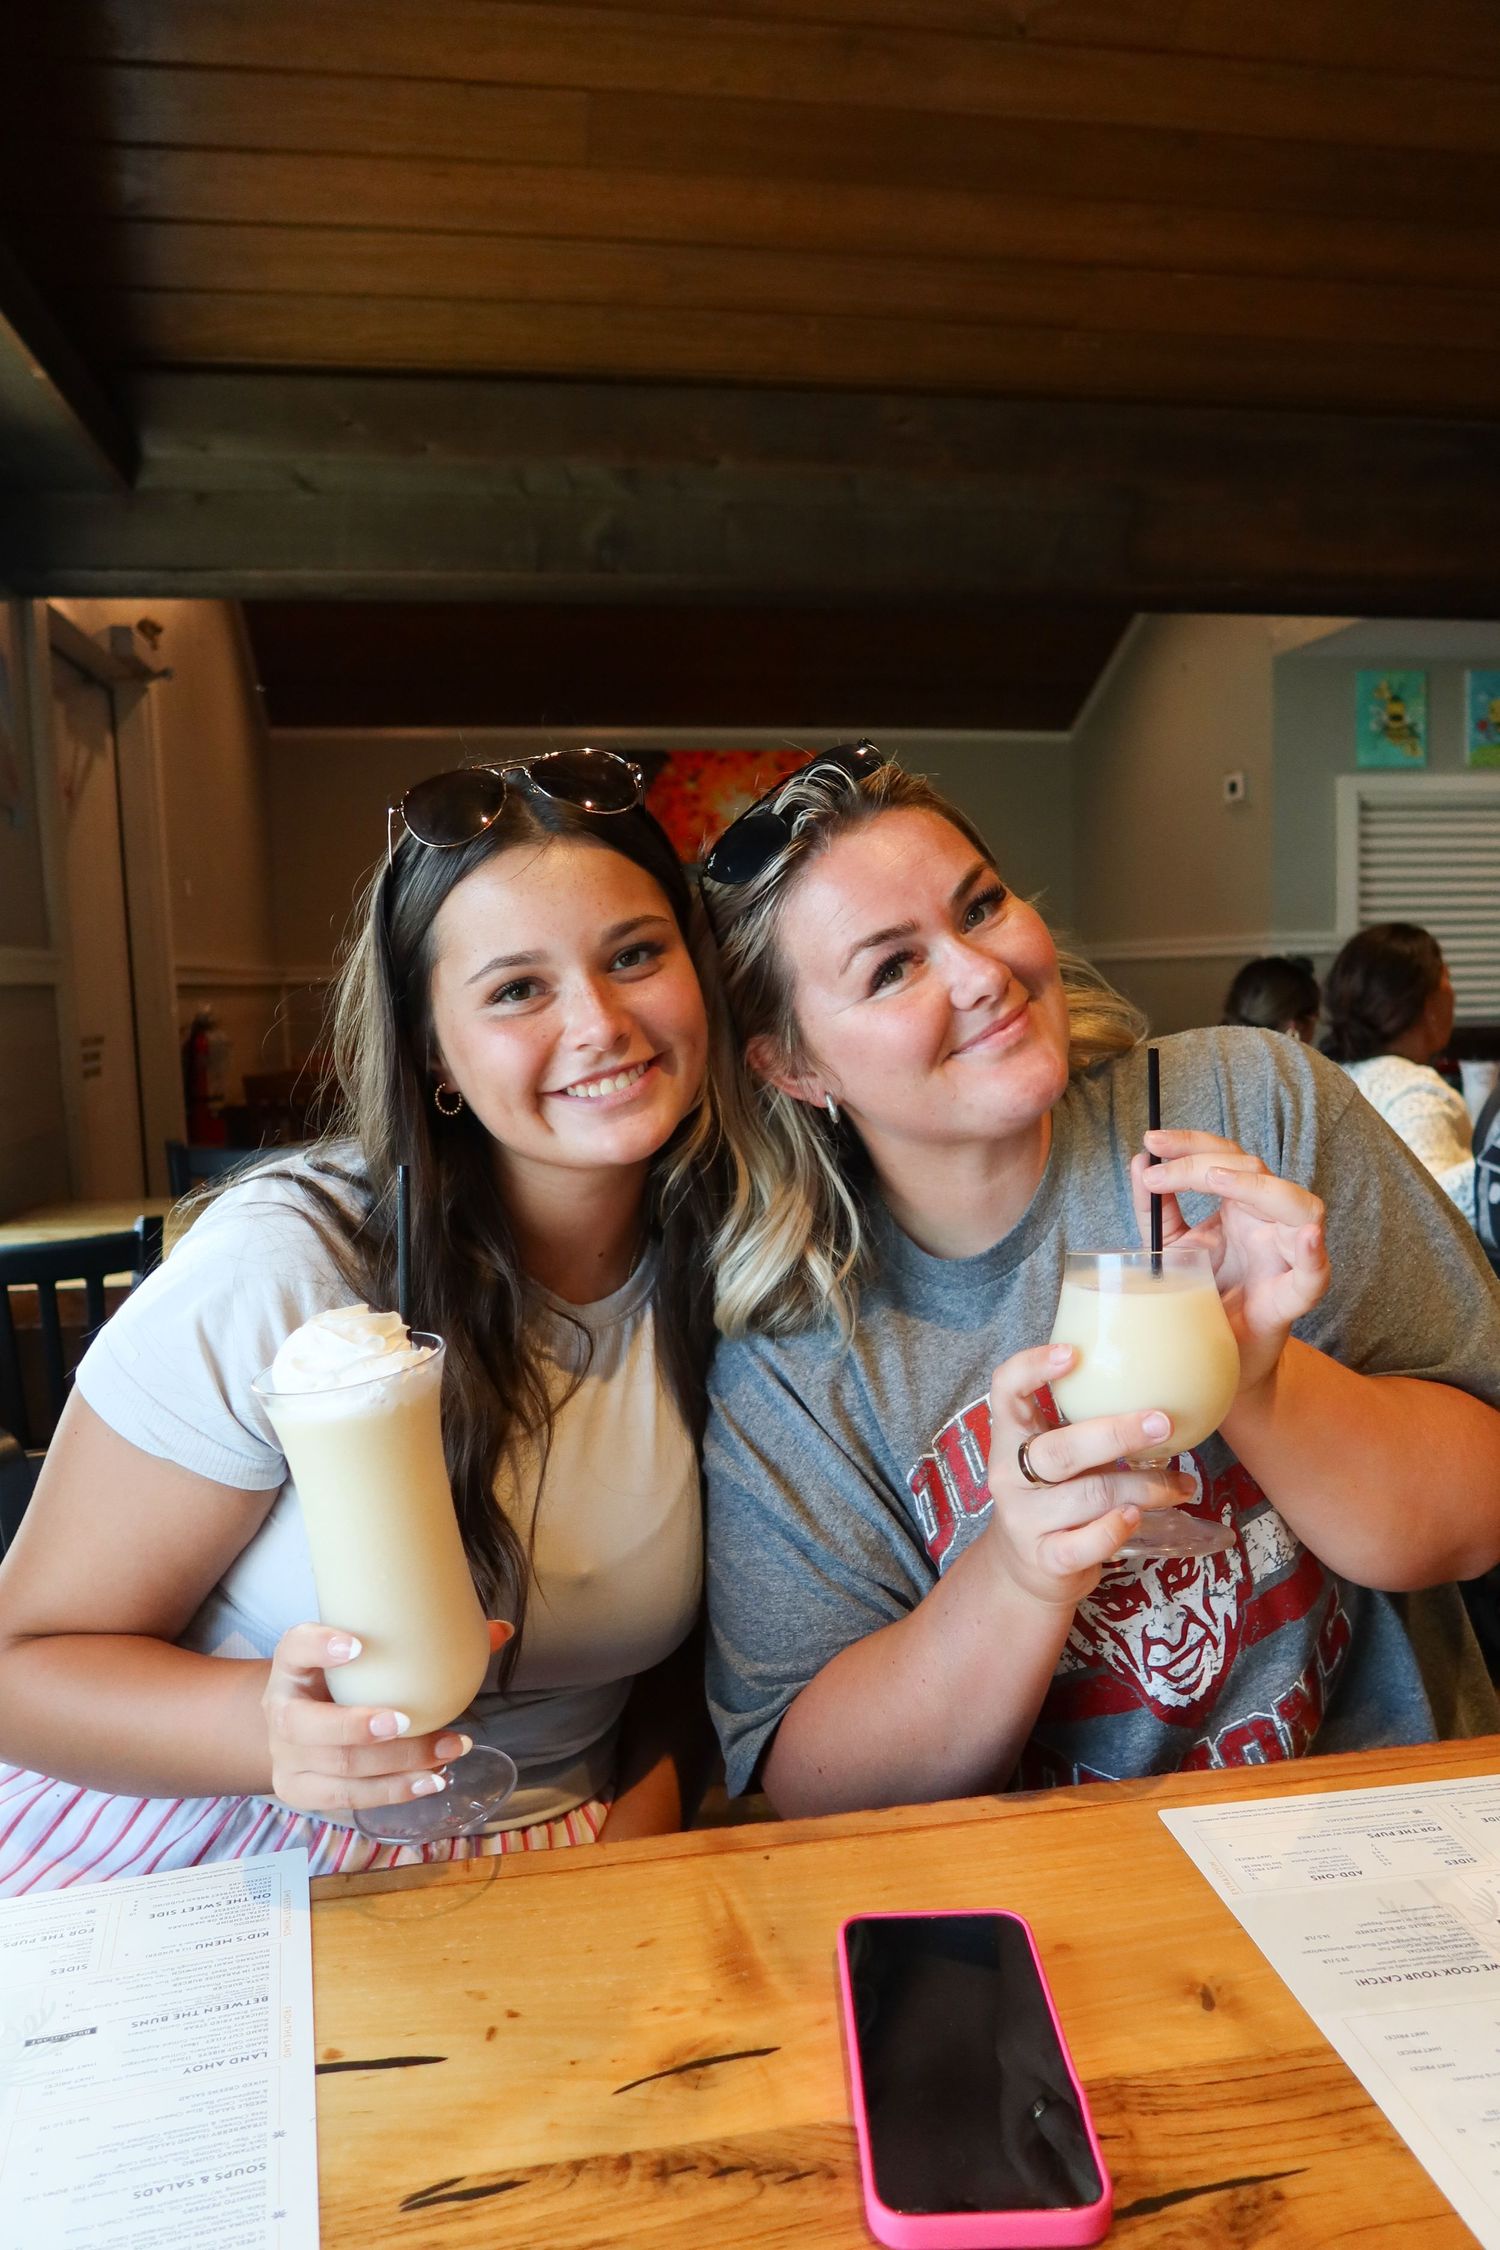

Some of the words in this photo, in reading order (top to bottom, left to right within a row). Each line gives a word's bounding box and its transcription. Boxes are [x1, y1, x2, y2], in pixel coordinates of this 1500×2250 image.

[1366, 1830, 1394, 1838] PUPS
[1395, 1827, 1418, 1835] THE
[1420, 1824, 1442, 1832] FOR
[1444, 1856, 1477, 1865] SIDES
[1309, 1869, 1362, 1881] ADD-ONS
[224, 1896, 248, 1905] THE
[252, 1891, 270, 1900] ON
[180, 1900, 222, 1913] SWEET
[147, 1909, 176, 1919] SIDE
[40, 1932, 64, 1941] THE
[68, 1927, 94, 1936] FOR
[235, 1930, 269, 1942] KID'S
[2, 1937, 36, 1948] PUPS
[194, 1937, 231, 1949] MENU
[50, 1963, 88, 1975] SIDES
[1443, 1964, 1478, 1976] COOK
[1480, 1962, 1500, 1971] WE
[1353, 1973, 1402, 1986] CATCH!
[1403, 1969, 1438, 1980] YOUR
[203, 1995, 268, 2013] BETWEEN
[172, 2008, 199, 2020] THE
[130, 2015, 168, 2028] BUNS
[228, 2051, 267, 2064] LAND
[182, 2060, 224, 2074] AHOY
[214, 2162, 266, 2182] SOUPS
[199, 2174, 209, 2185] &
[132, 2178, 194, 2200] SALADS
